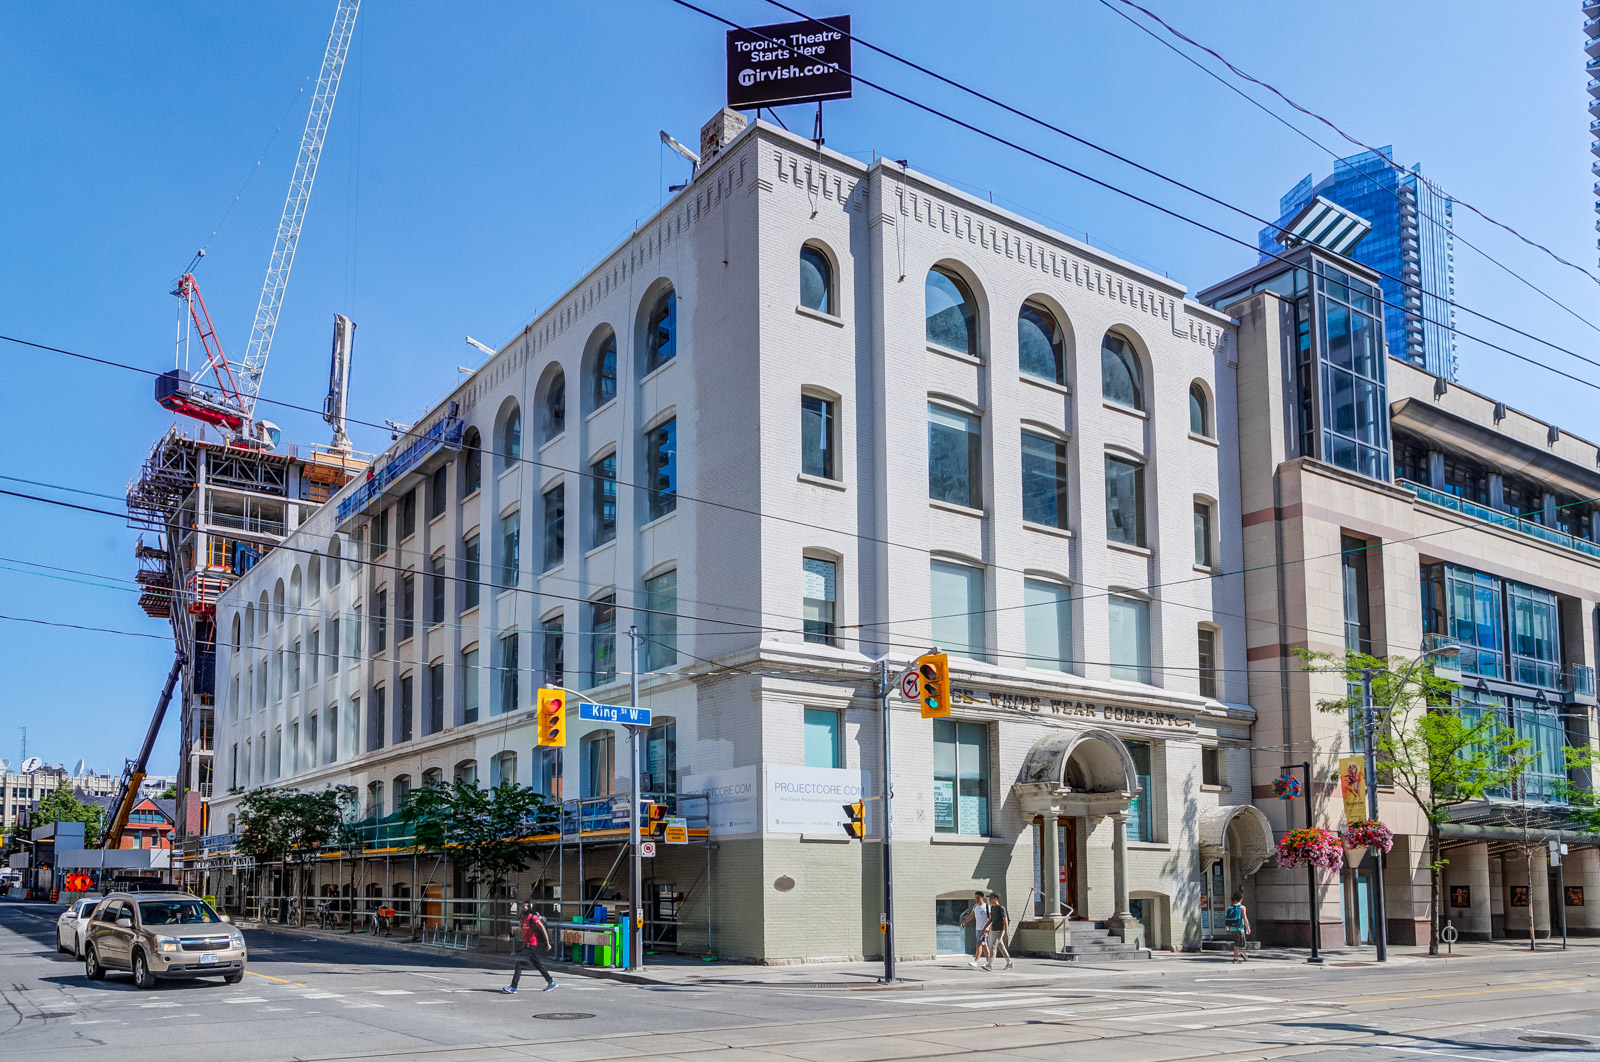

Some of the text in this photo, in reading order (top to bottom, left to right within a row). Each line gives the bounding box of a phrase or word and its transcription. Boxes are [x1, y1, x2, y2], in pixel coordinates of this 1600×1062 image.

[735, 31, 842, 52] Toronto Theatre
[751, 44, 826, 62] Starts Here
[738, 62, 839, 86] mirvish.com
[592, 705, 618, 721] King
[630, 709, 639, 720] W
[989, 692, 1041, 711] WHITE
[1050, 700, 1097, 717] WEAR
[1103, 706, 1176, 726] COMPANY
[774, 782, 865, 796] PROJECTCORE.COM
